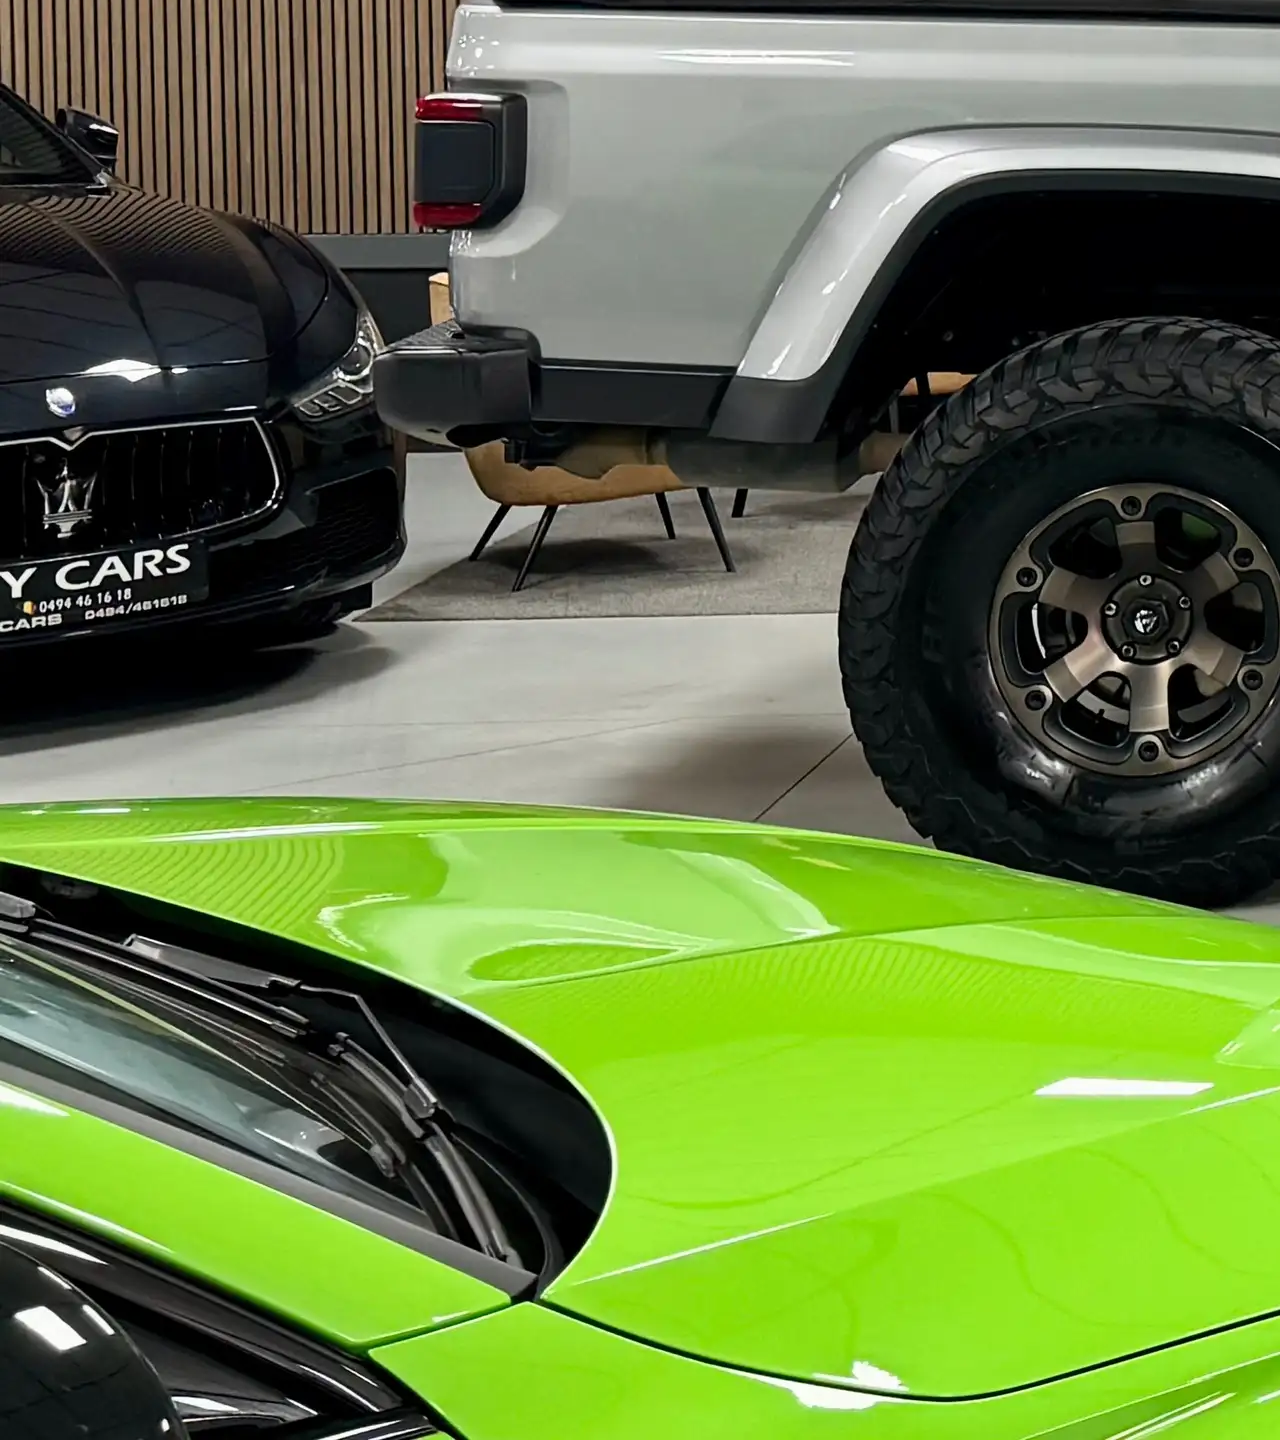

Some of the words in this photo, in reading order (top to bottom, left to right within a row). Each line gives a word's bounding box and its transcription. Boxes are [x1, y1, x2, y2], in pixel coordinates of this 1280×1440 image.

[0, 567, 38, 598] Y
[55, 543, 191, 591] CARS
[39, 597, 72, 613] 0494
[76, 594, 92, 608] 46
[98, 591, 112, 605] 16
[117, 588, 132, 601] 18
